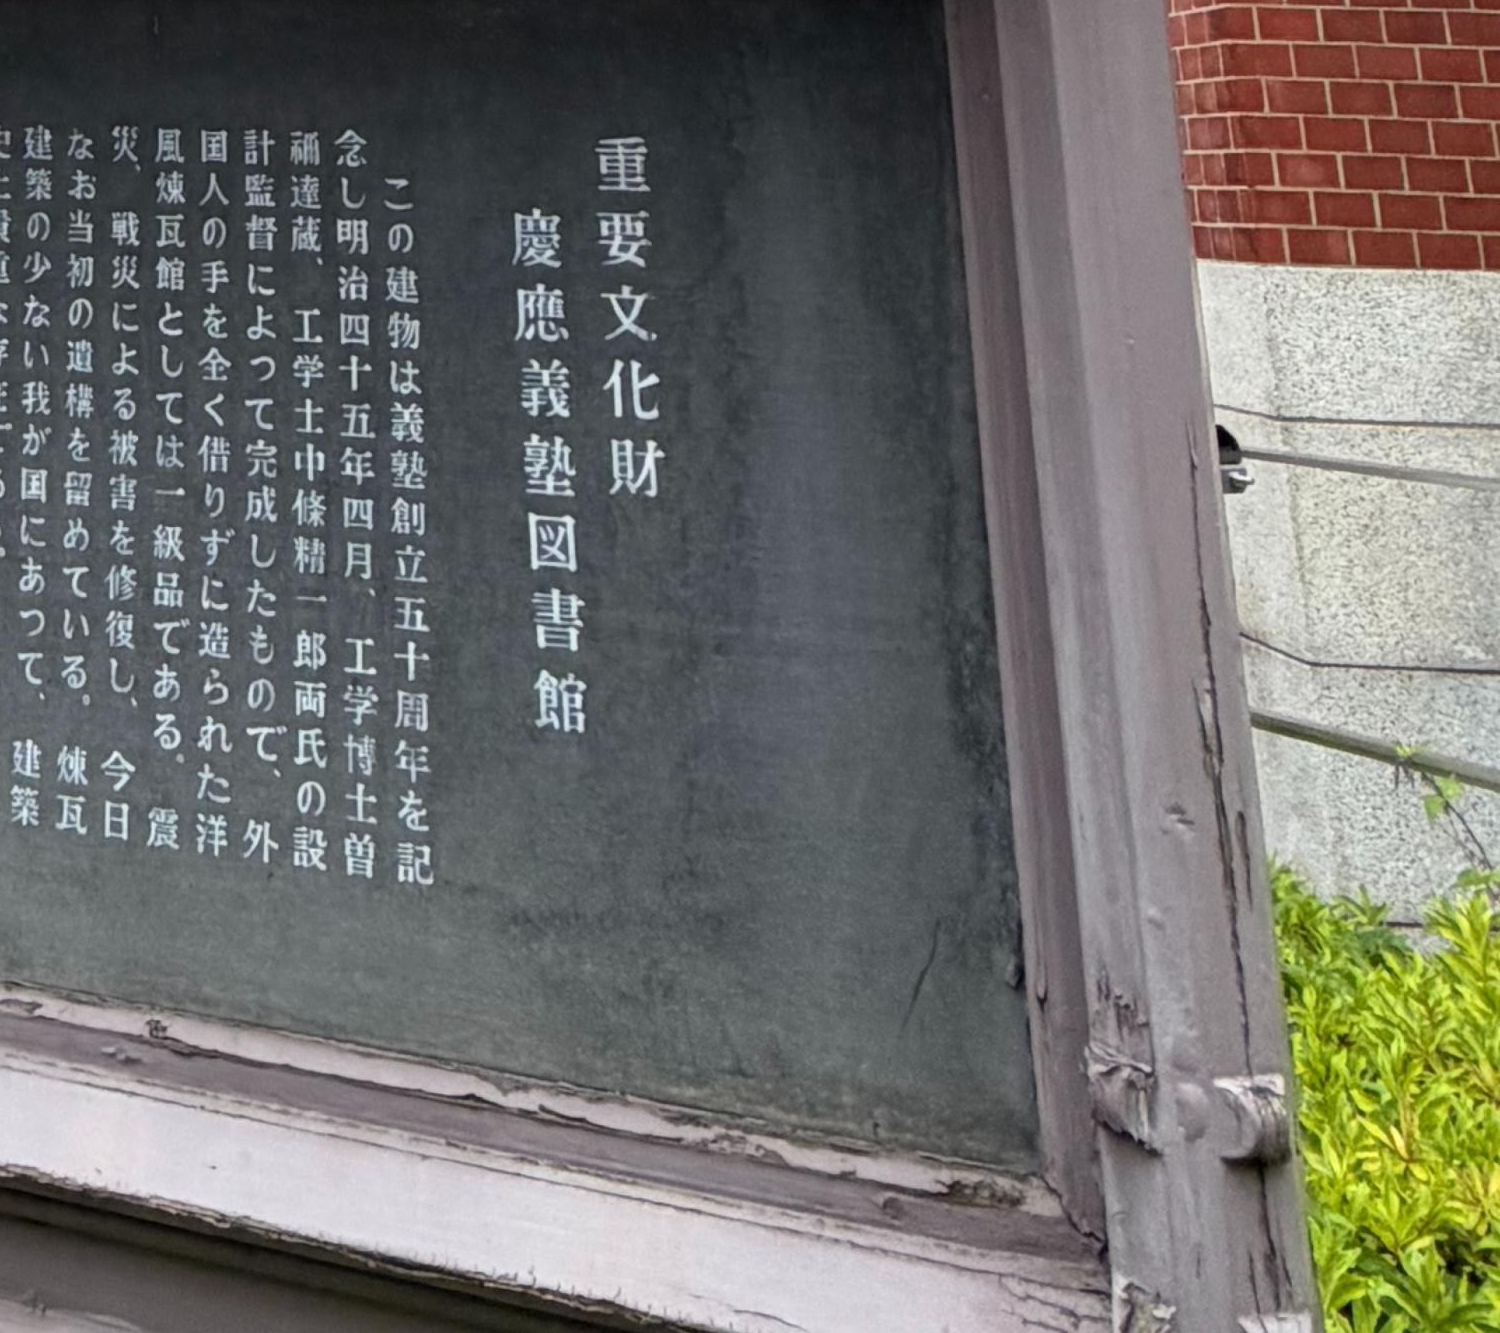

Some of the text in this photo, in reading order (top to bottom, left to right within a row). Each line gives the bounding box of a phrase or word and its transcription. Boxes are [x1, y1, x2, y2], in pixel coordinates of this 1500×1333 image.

[196, 130, 236, 857] 国人の手を全く借りずに造られた洋
[384, 176, 434, 885] この建物は義塾創立五十周年を記
[511, 207, 586, 733] 慶應義塾図書館
[594, 136, 665, 498] 重要文化財
